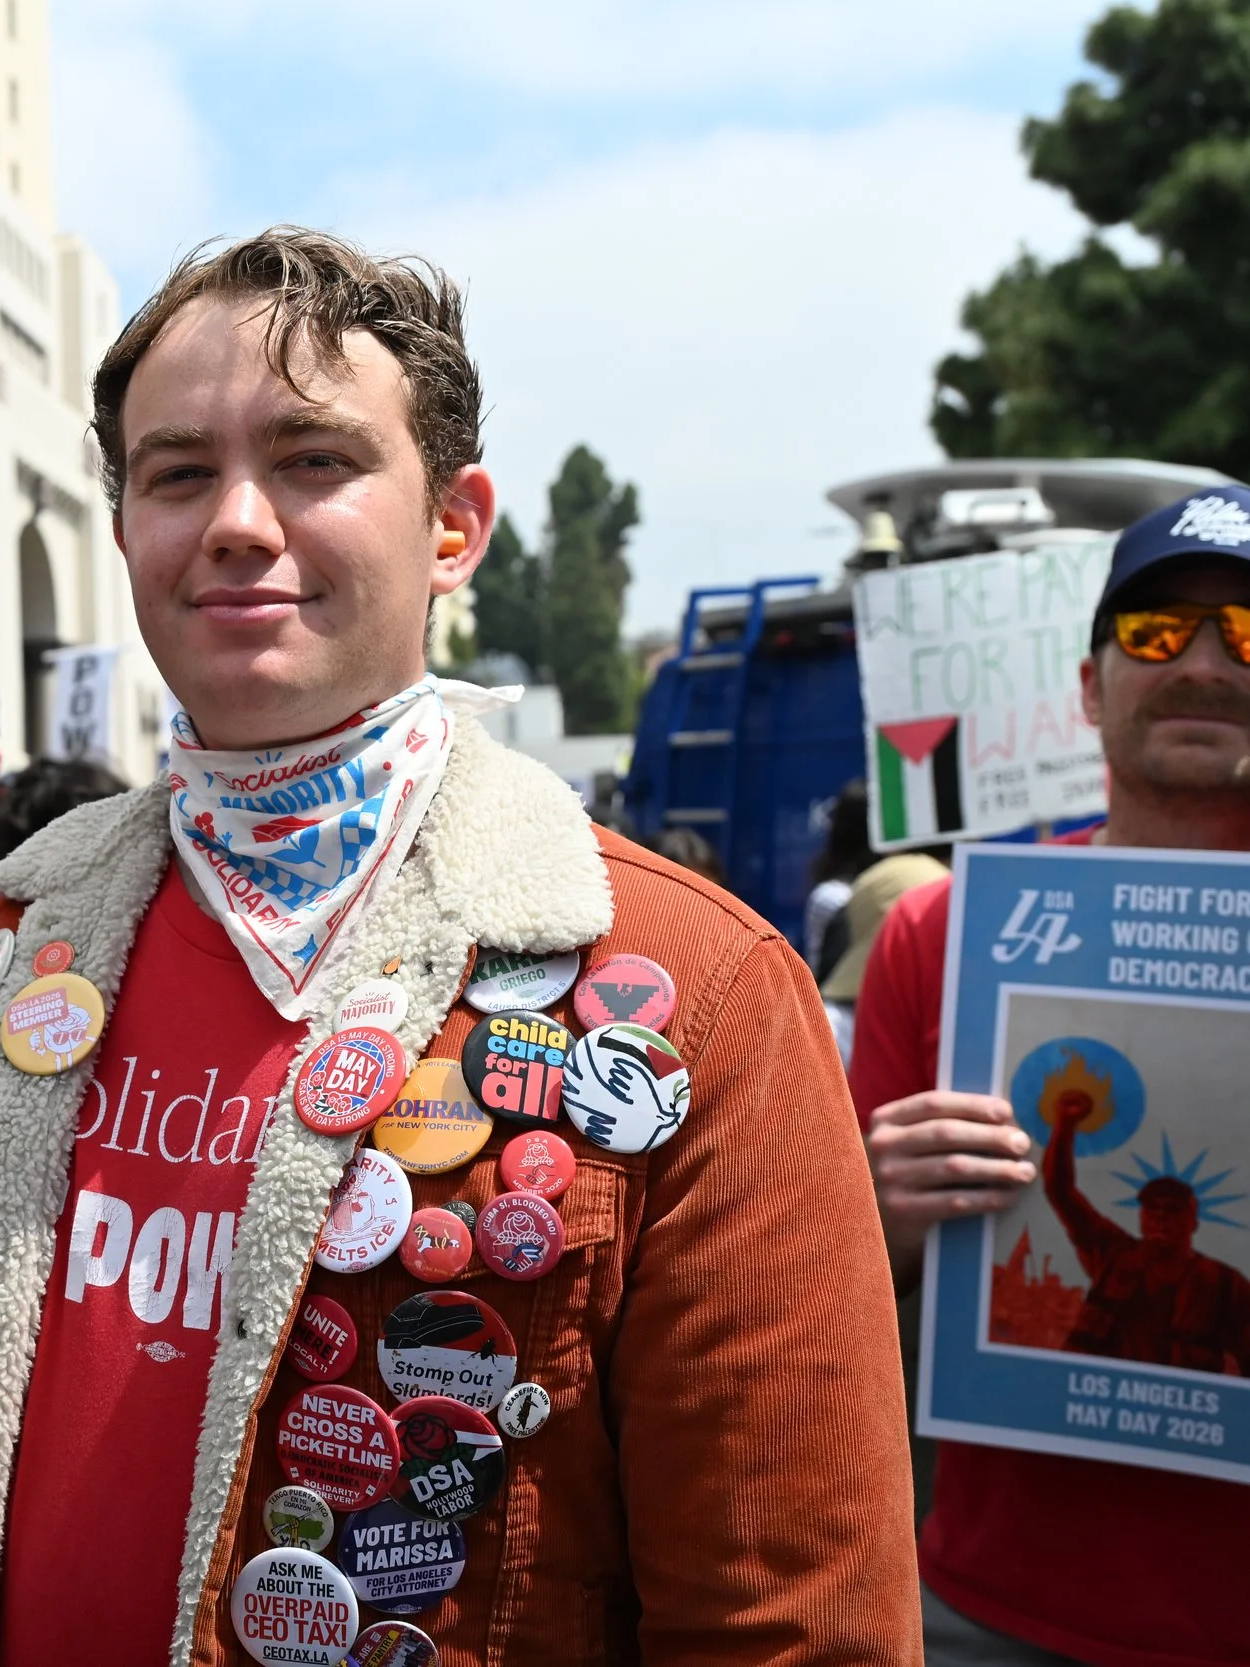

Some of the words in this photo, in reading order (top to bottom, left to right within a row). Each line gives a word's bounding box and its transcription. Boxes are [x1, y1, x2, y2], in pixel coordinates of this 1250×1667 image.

[909, 637, 1016, 711] FOR
[214, 742, 346, 792] Socialist
[1113, 883, 1193, 913] FIGHT
[1200, 887, 1250, 917] FOR
[1111, 920, 1240, 954] WORKING
[499, 968, 546, 991] GRIEGO
[578, 981, 589, 997] Con
[587, 970, 597, 980] La
[639, 961, 670, 1002] Campesinos
[40, 992, 61, 1004] 2026
[347, 992, 391, 1008] Socialist
[521, 988, 561, 1012] DISTRICT
[558, 980, 566, 988] 5
[10, 999, 64, 1022] STEERING
[12, 1009, 62, 1031] MEMBER
[341, 1000, 396, 1024] MAJORITY
[489, 1018, 568, 1050] child
[318, 1040, 336, 1055] DSA
[338, 1033, 347, 1043] IS
[349, 1031, 368, 1040] MAY
[368, 1034, 385, 1047] DAY
[383, 1044, 396, 1078] STRONG
[335, 1049, 377, 1079] MAY
[485, 1052, 528, 1075] for
[487, 1036, 565, 1066] care
[298, 1078, 308, 1097] DSA
[326, 1069, 368, 1094] DAY
[481, 1062, 564, 1121] all
[300, 1097, 308, 1106] IS
[302, 1104, 318, 1120] MAY
[317, 1115, 334, 1127] DAY
[335, 1106, 371, 1127] STRONG
[423, 1122, 451, 1131] YORK
[453, 1123, 477, 1132] CITY
[383, 1146, 469, 1170] ZOHRANFORNYC.COM
[513, 1180, 544, 1195] MEMBER
[545, 1178, 563, 1193] 2020
[483, 1208, 499, 1232] ¡CUBA
[512, 1199, 549, 1220] BLOQUEO
[546, 1220, 557, 1236] NO!
[318, 1240, 368, 1261] MELTS
[370, 1224, 395, 1251] ICE
[303, 1304, 349, 1347] UNITE
[288, 1339, 318, 1367] LOCAL
[393, 1361, 455, 1384] Stomp
[459, 1369, 494, 1387] Out
[392, 1382, 494, 1408] Slumlords!
[505, 1386, 538, 1412] CEASEFIRE
[538, 1390, 549, 1406] NOW
[1068, 1372, 1111, 1399] LOS
[1116, 1378, 1220, 1415] ANGELES
[301, 1393, 376, 1426] NEVER
[1066, 1402, 1112, 1428] MAY
[1117, 1408, 1161, 1436] DAY
[287, 1411, 363, 1444] CROSS
[369, 1432, 385, 1450] A
[505, 1421, 518, 1435] FREE
[518, 1416, 547, 1436] PALESTINE
[278, 1429, 347, 1459] PICKET
[348, 1446, 393, 1470] LINE
[303, 1478, 361, 1499] SOLIDARITY
[319, 1471, 360, 1488] AMERICA
[410, 1458, 474, 1503] DSA
[269, 1490, 288, 1505] TENGO
[289, 1489, 317, 1503] PUERTO
[426, 1484, 475, 1511] HOLLYWOOD
[434, 1494, 474, 1518] LABOR
[353, 1522, 406, 1548] VOTE
[411, 1520, 450, 1541] FOR
[356, 1539, 454, 1573] MARISSA
[268, 1561, 297, 1578] ASK
[301, 1564, 323, 1580] ME
[366, 1576, 386, 1588] FOR
[388, 1573, 406, 1585] LOS
[408, 1566, 453, 1582] ANGELES
[256, 1577, 304, 1595] ABOUT
[307, 1582, 335, 1598] THE
[371, 1585, 394, 1597] CITY
[395, 1577, 448, 1593] ATTORNEY
[244, 1593, 349, 1623] OVERPAID
[243, 1614, 289, 1642] CEO
[293, 1619, 347, 1648] TAX!
[263, 1645, 329, 1664] CEOTAX.LA
[359, 1643, 373, 1659] ARE
[372, 1635, 394, 1662] PANTRY
